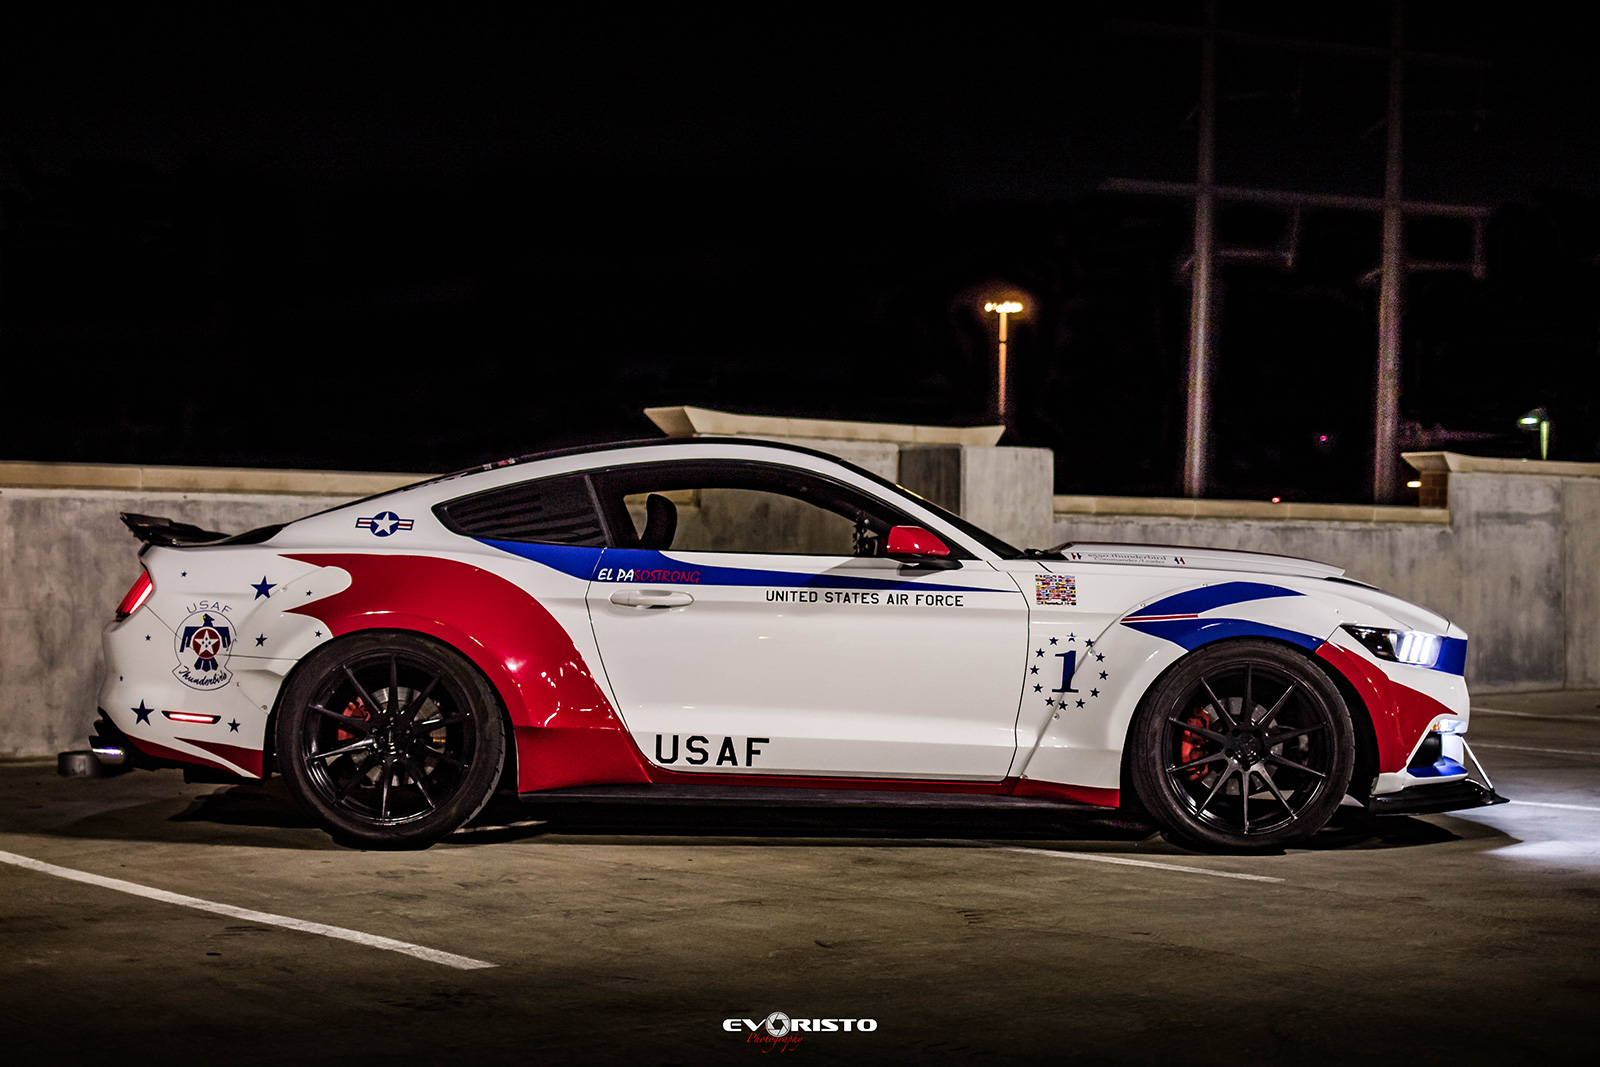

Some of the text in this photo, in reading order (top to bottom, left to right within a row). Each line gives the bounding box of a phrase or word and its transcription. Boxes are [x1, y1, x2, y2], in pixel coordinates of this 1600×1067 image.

[597, 568, 613, 581] EL
[186, 600, 233, 614] USAF
[766, 590, 964, 607] UNITED STATES AIR FORCE
[1051, 650, 1079, 693] 1
[655, 734, 770, 767] USAF
